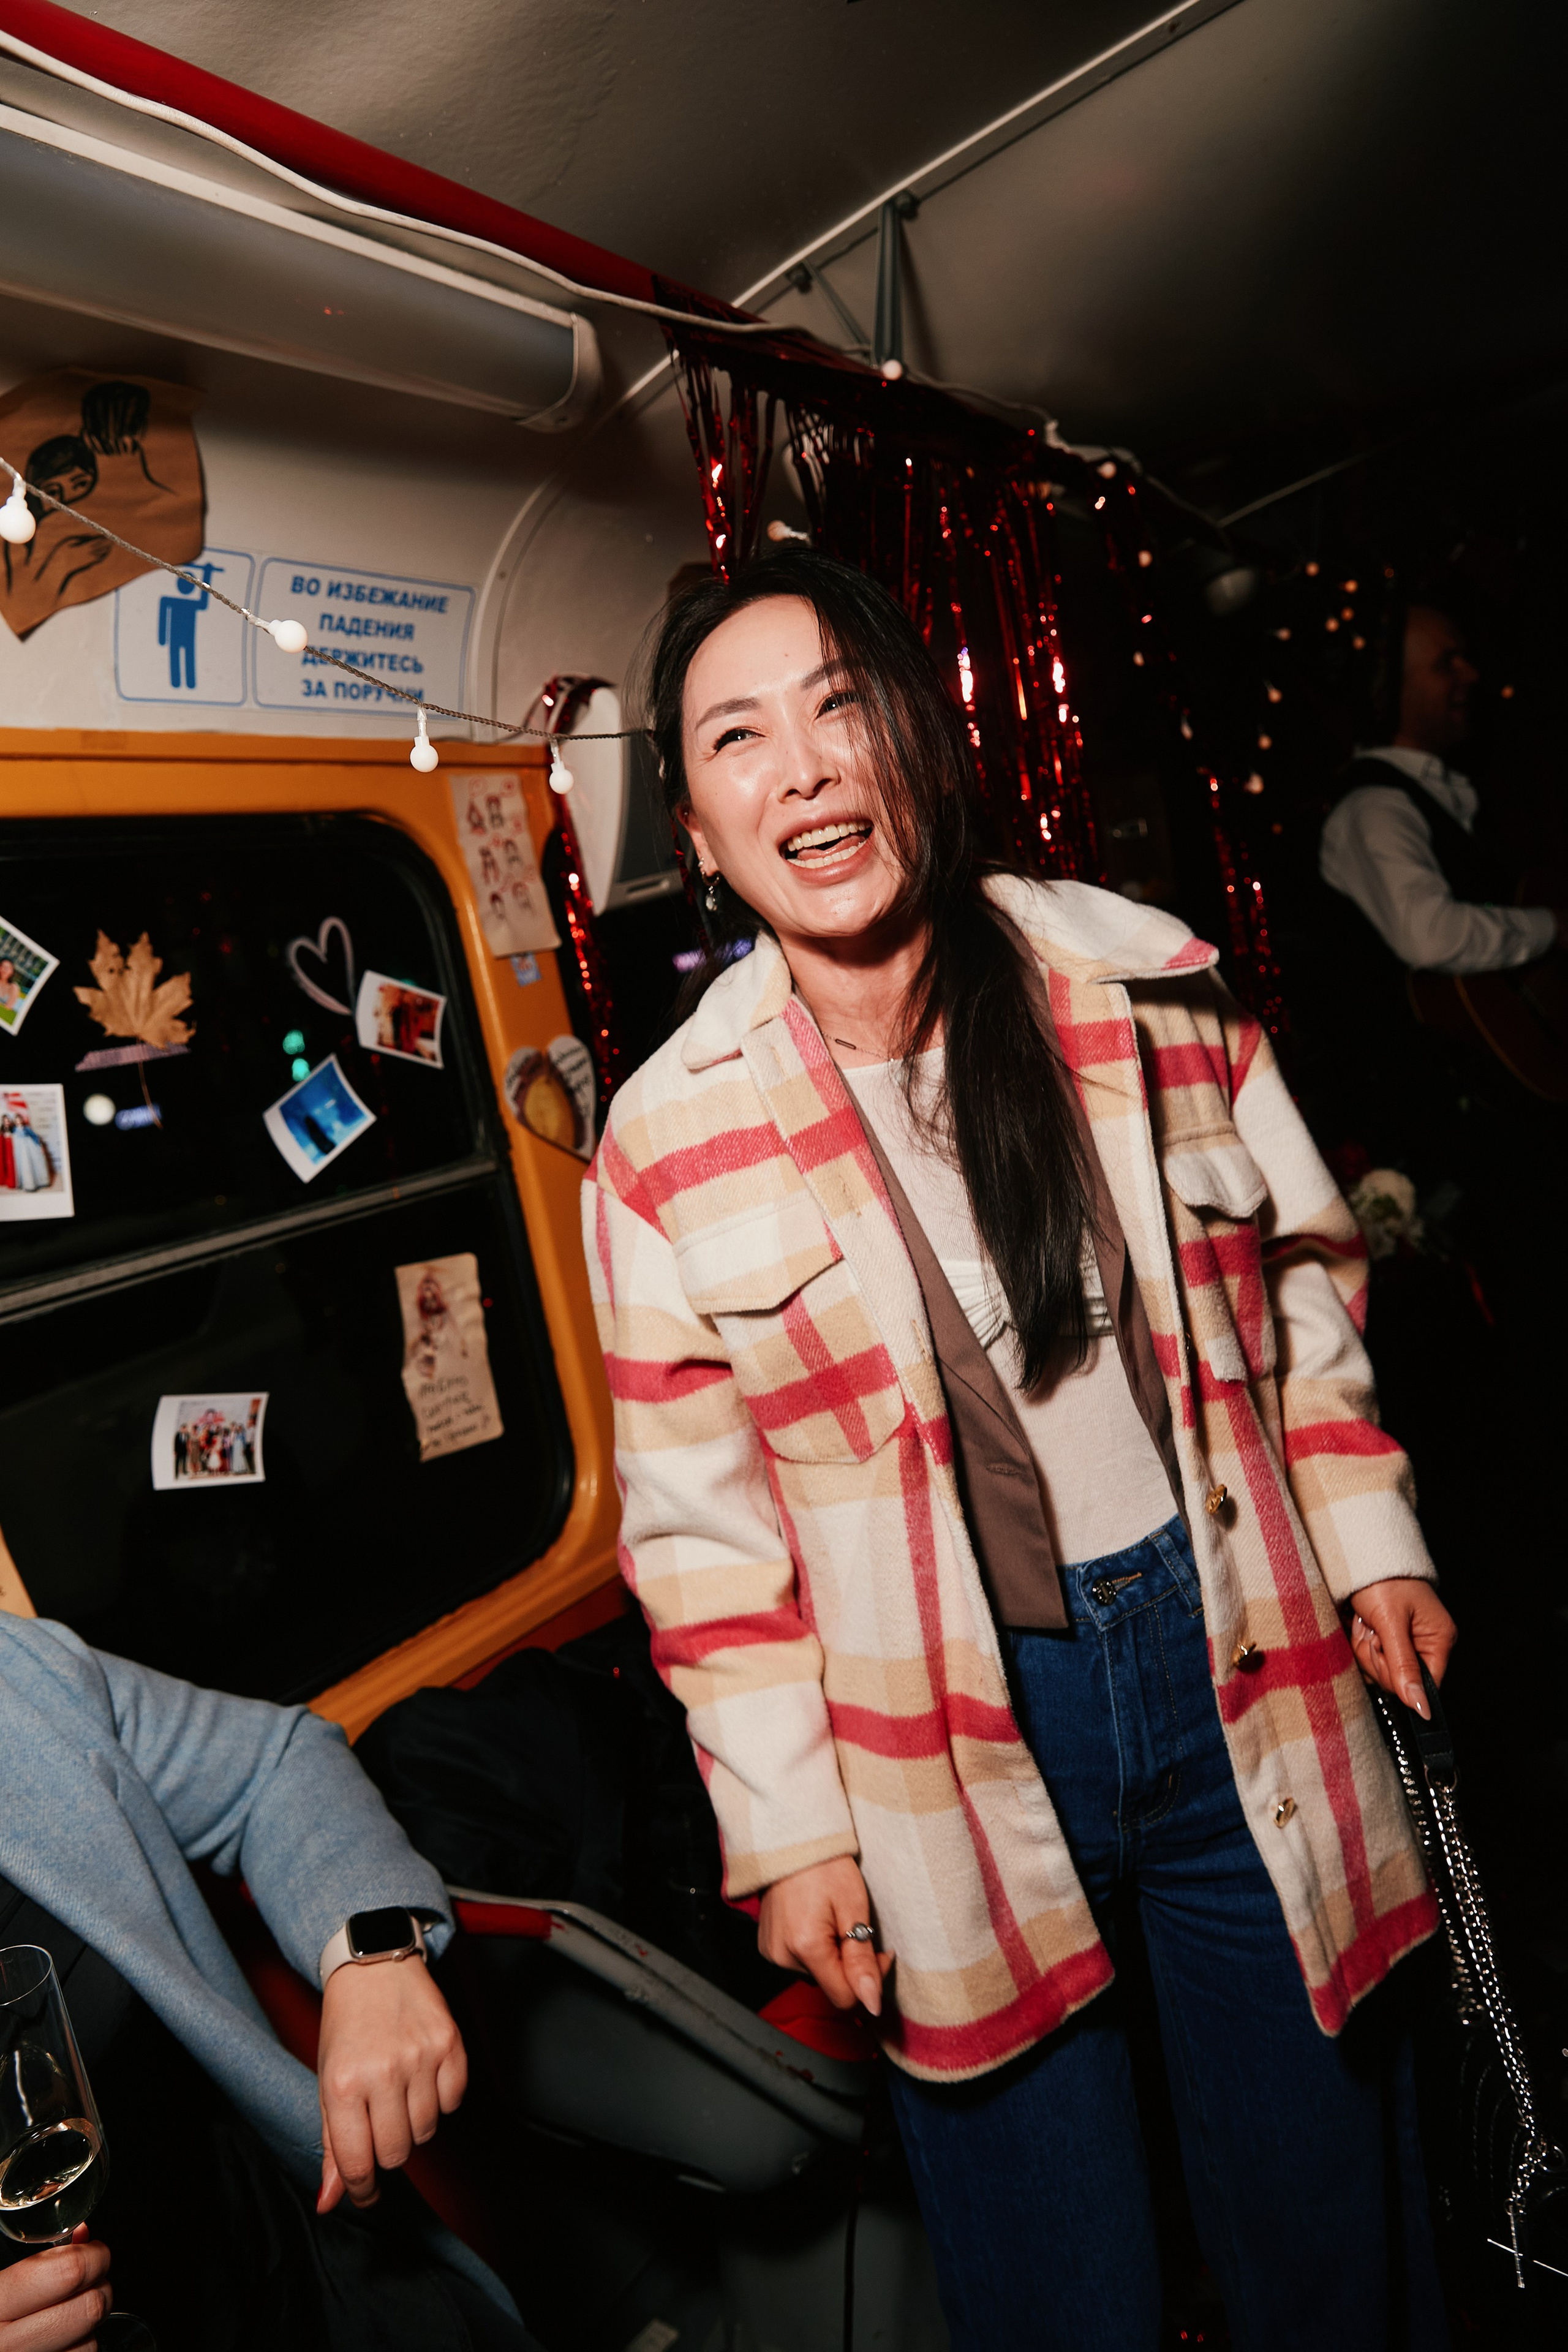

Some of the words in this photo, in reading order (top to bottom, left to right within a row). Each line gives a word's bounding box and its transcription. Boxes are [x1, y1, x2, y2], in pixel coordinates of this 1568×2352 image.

[291, 575, 320, 595] ВО
[328, 581, 449, 613] ИЗБЕЖАНИЕ
[319, 613, 415, 641] ПАДЕНИЯ
[302, 646, 424, 673] ДЕРЖИТЕСЬ
[302, 679, 326, 697] ЗА
